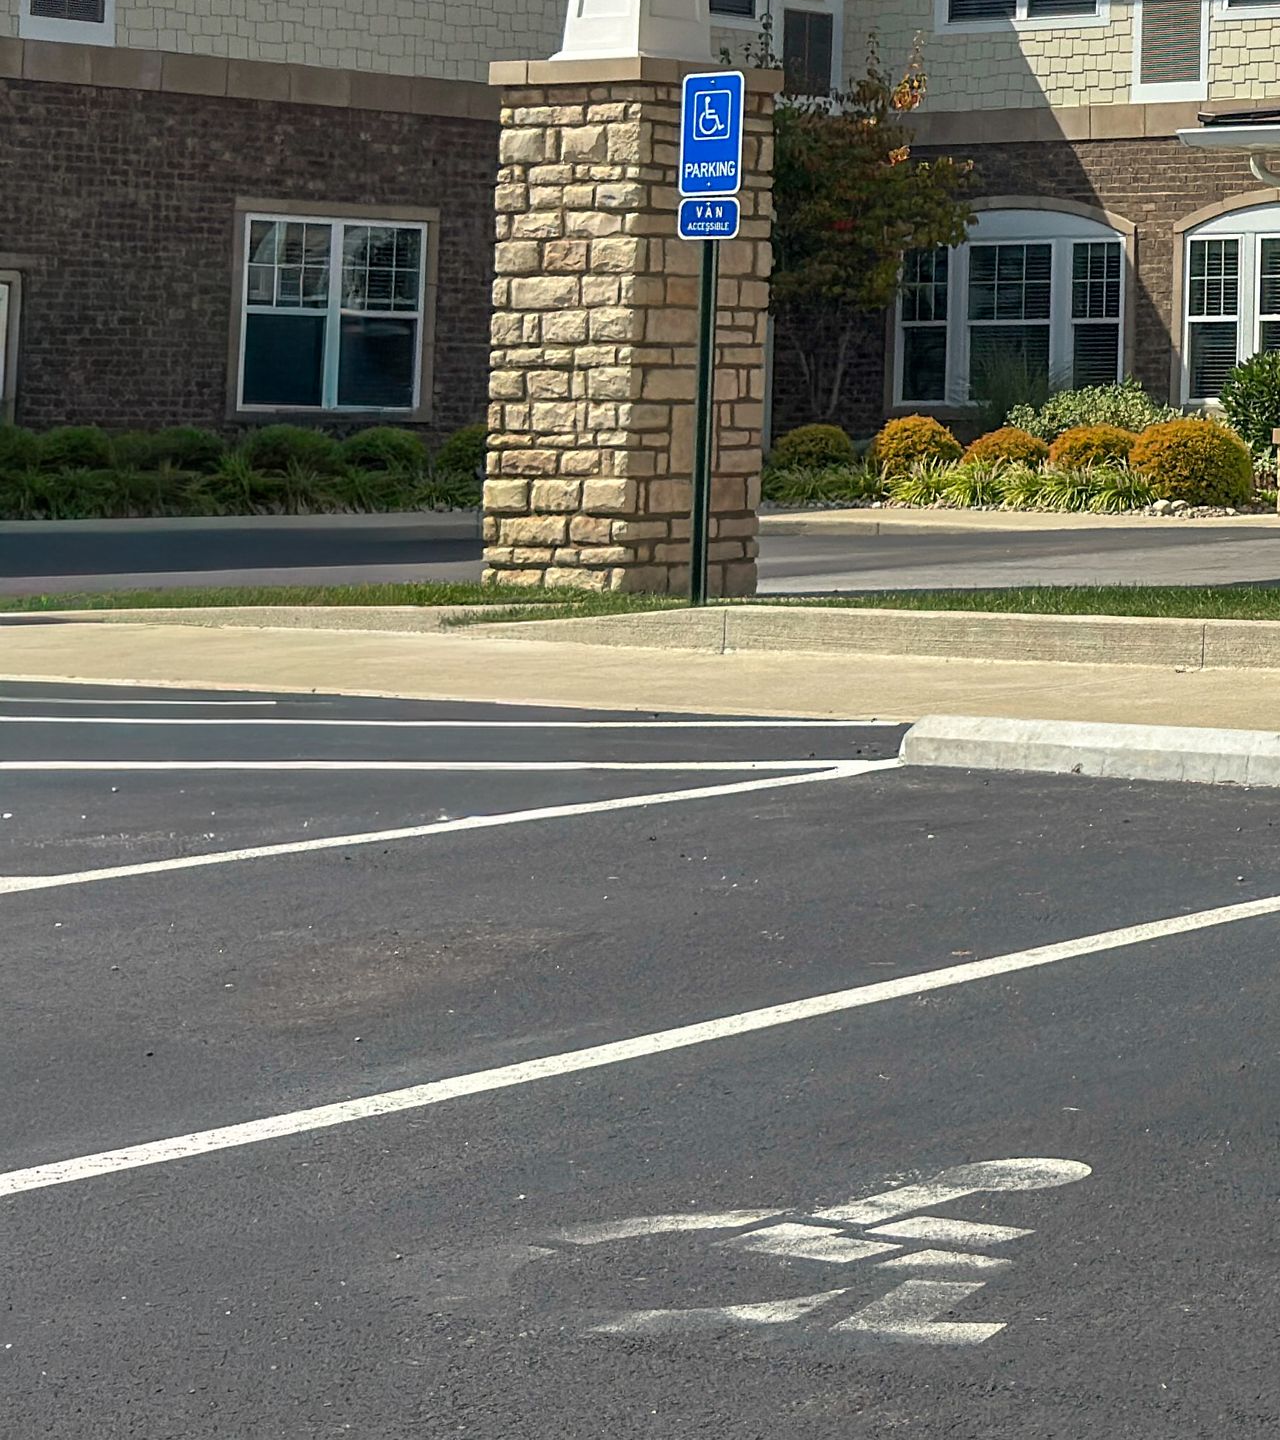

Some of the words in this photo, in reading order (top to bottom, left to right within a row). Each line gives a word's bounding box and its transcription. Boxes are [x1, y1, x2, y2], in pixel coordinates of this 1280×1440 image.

[685, 160, 736, 179] PARKING
[696, 205, 723, 218] VAN
[687, 221, 730, 232] ACCESSIBLE
